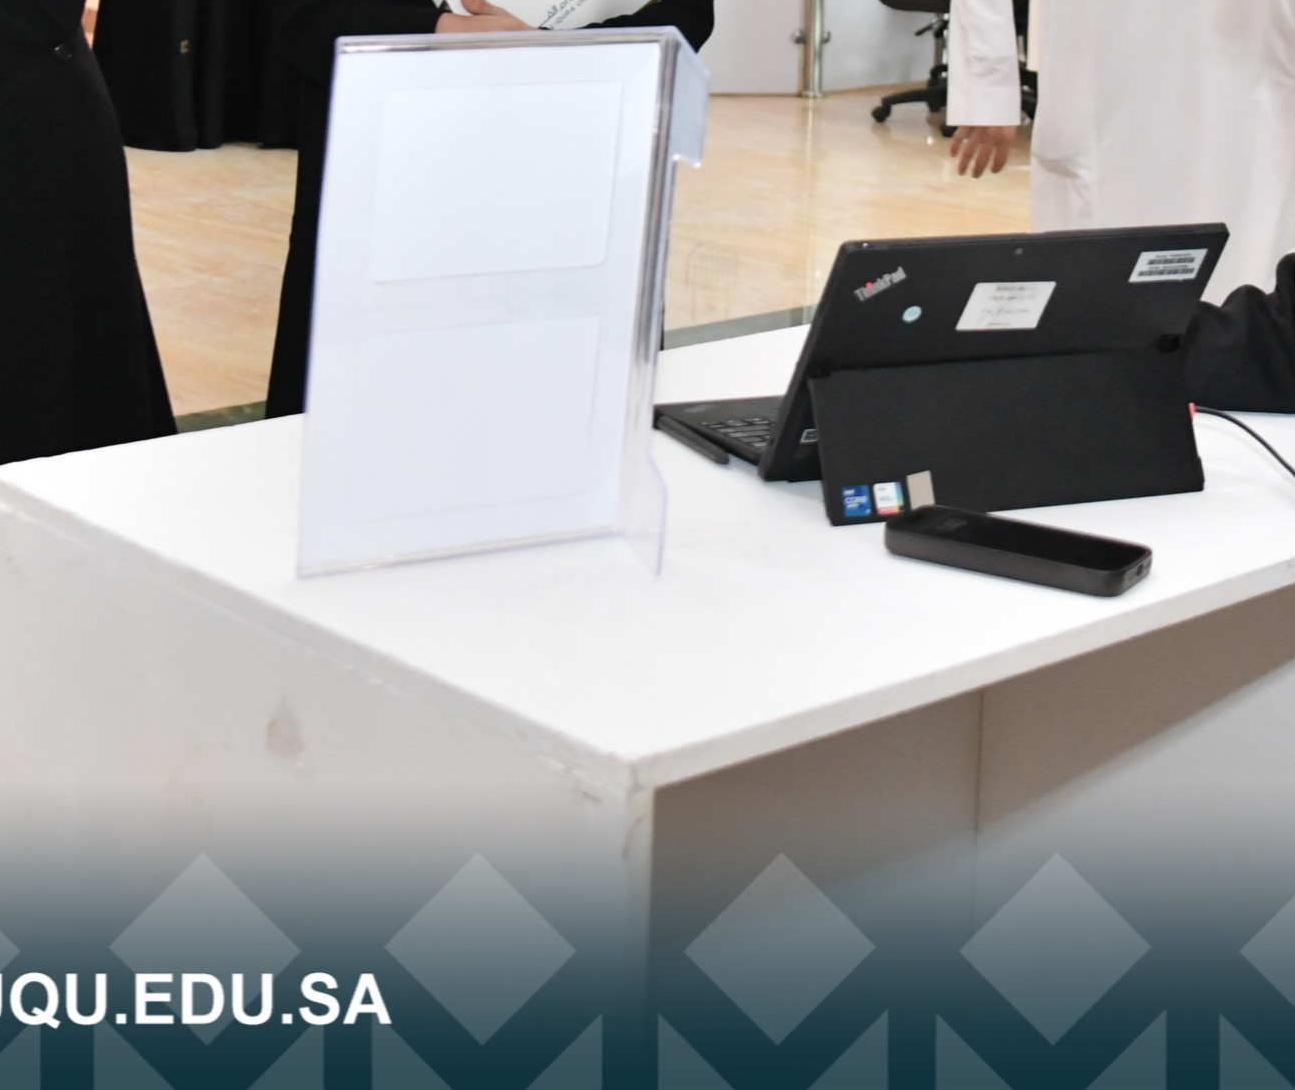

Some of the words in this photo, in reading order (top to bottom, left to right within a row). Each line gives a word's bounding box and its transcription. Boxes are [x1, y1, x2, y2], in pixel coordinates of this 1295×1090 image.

[538, 4, 559, 28] الق
[549, 6, 576, 30] L-QURA
[853, 266, 906, 301] ThinkPad
